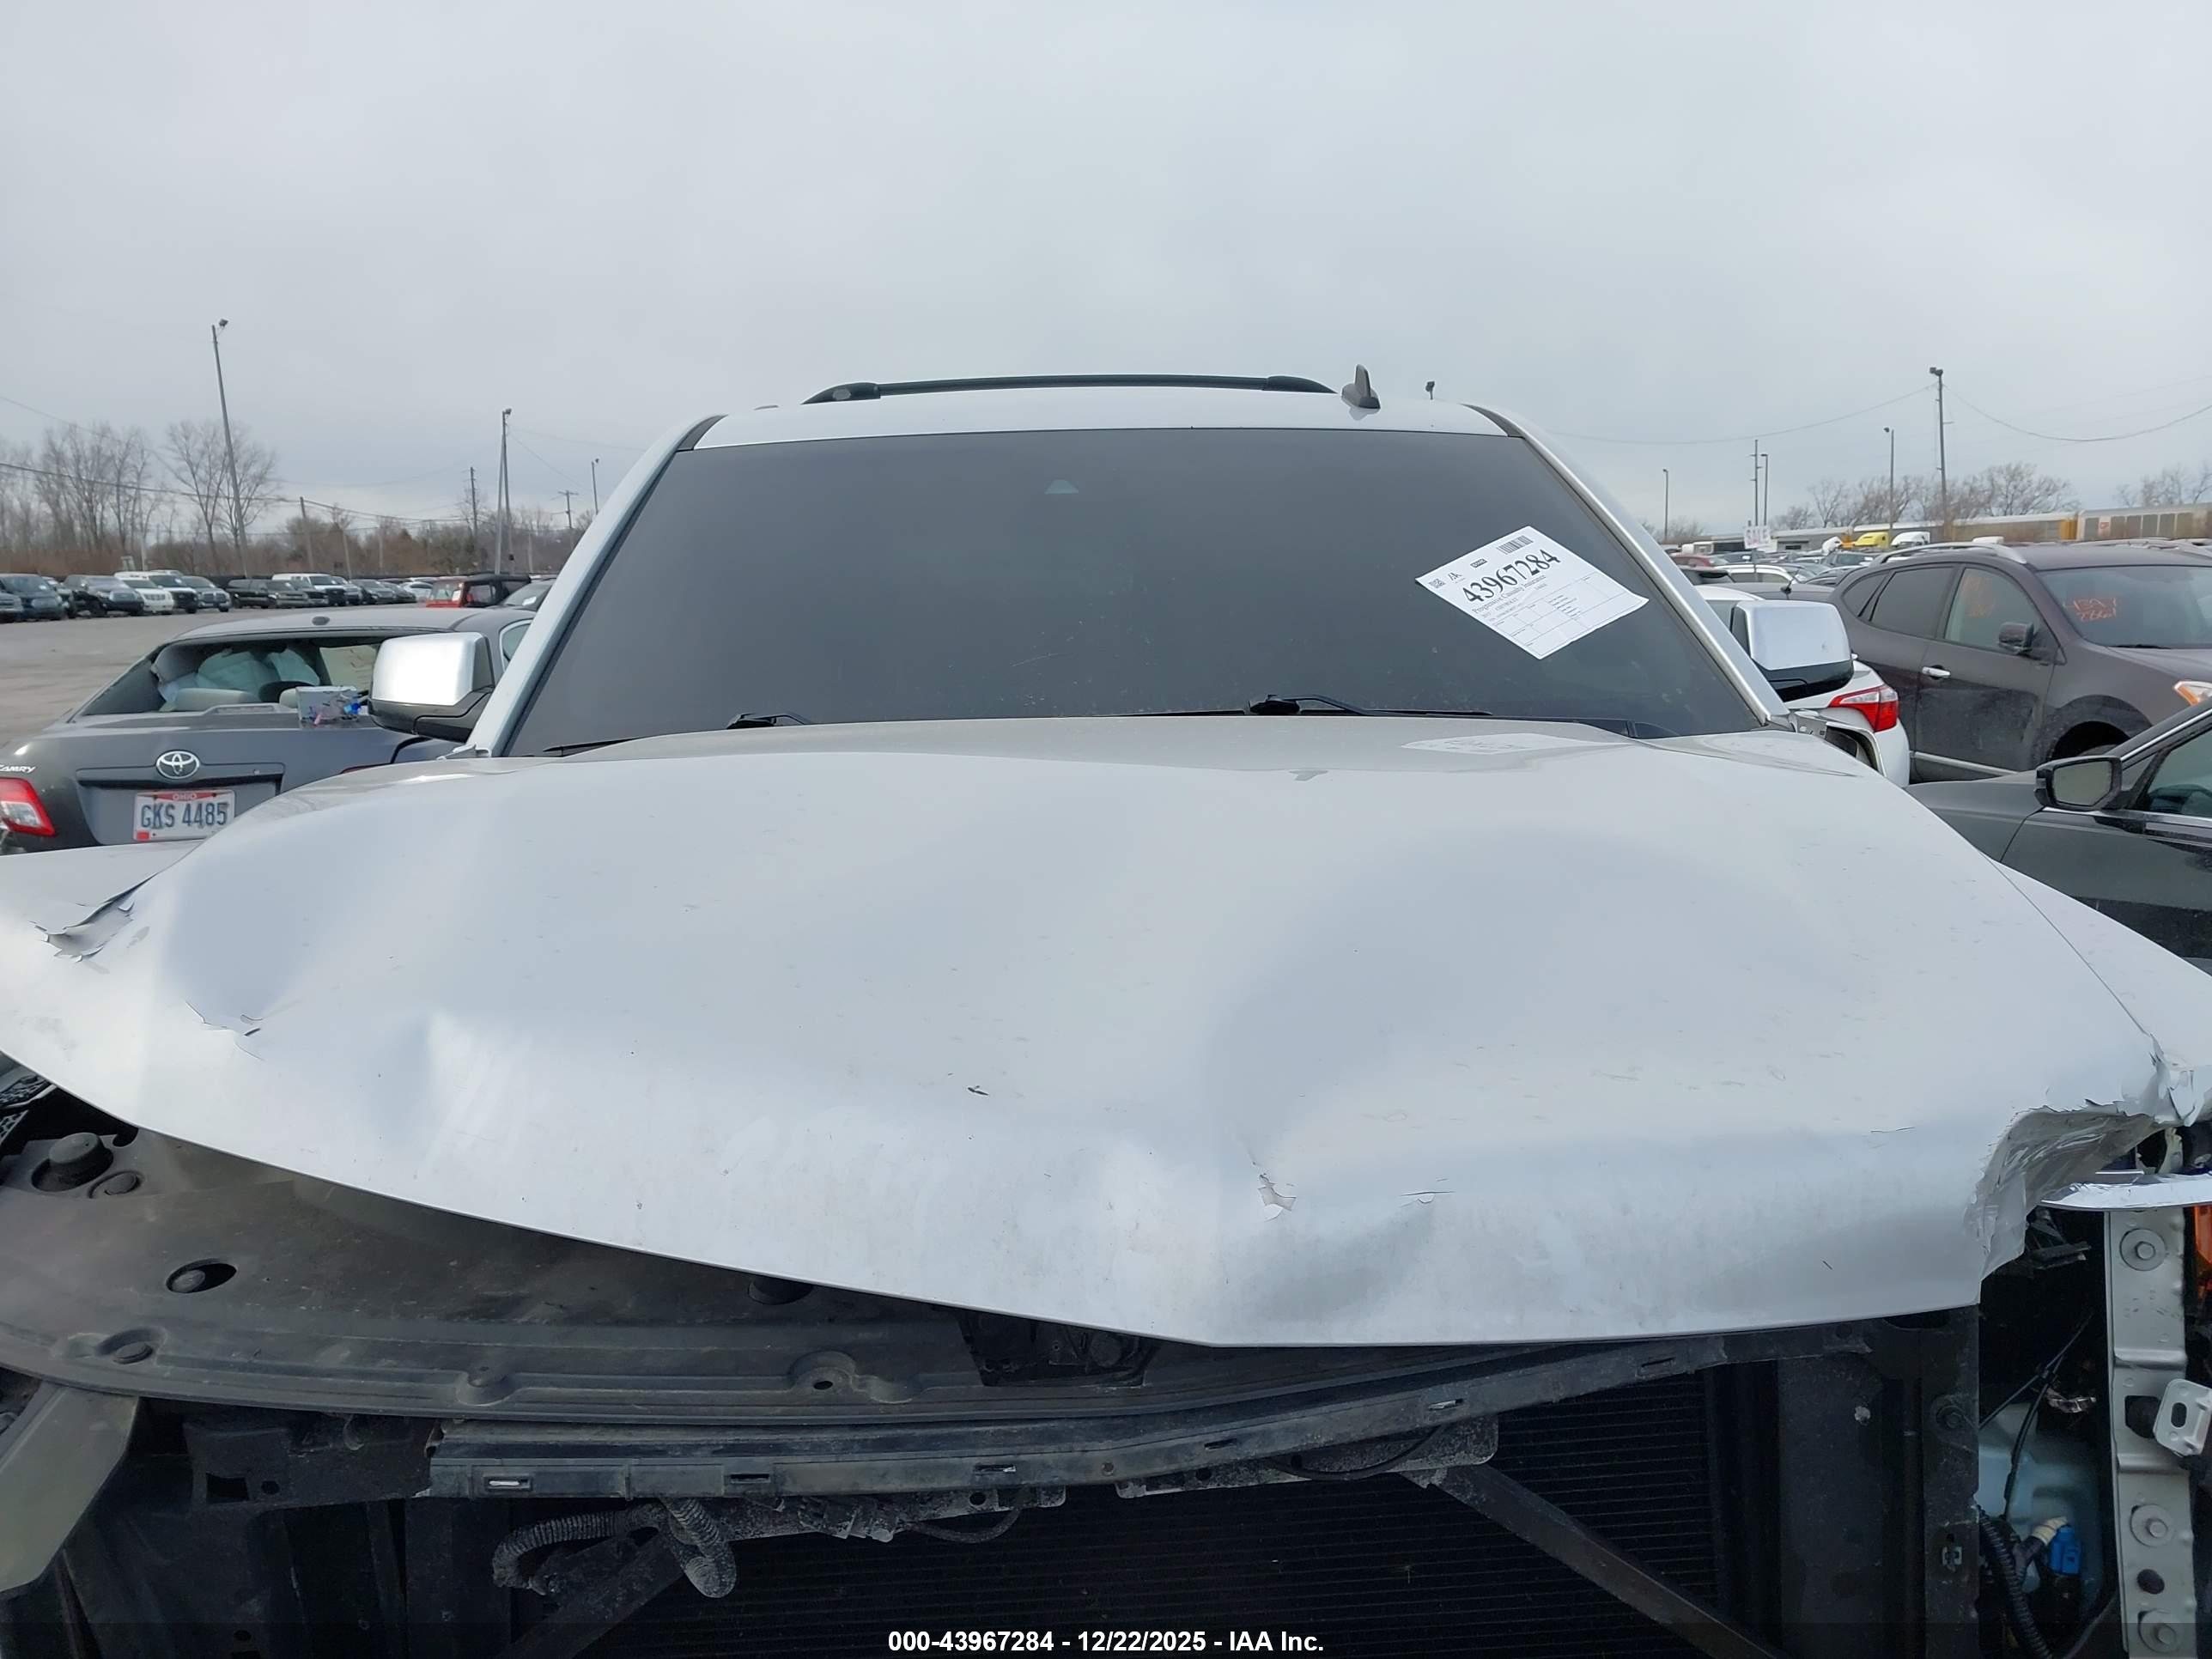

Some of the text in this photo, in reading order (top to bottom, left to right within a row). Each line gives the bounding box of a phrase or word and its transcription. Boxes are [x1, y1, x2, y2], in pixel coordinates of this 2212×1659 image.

[1462, 549, 1560, 605] 43967284
[141, 802, 228, 829] GKS 4485
